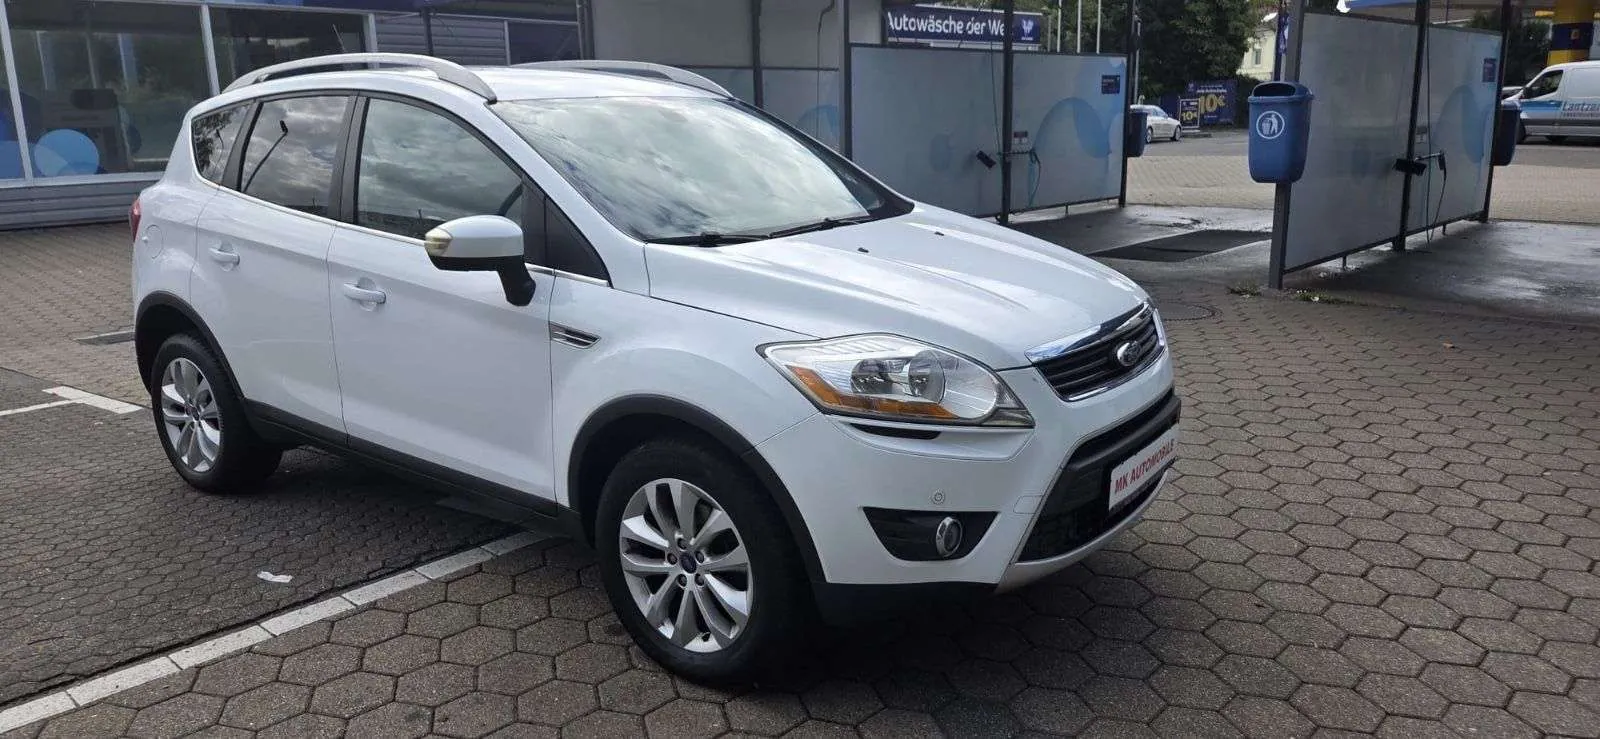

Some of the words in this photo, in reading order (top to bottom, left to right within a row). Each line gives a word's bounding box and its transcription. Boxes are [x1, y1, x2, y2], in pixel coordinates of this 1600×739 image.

[965, 16, 986, 35] der
[988, 19, 1004, 36] We
[1114, 473, 1128, 494] MK
[1130, 438, 1175, 484] AUTOMOBILE
